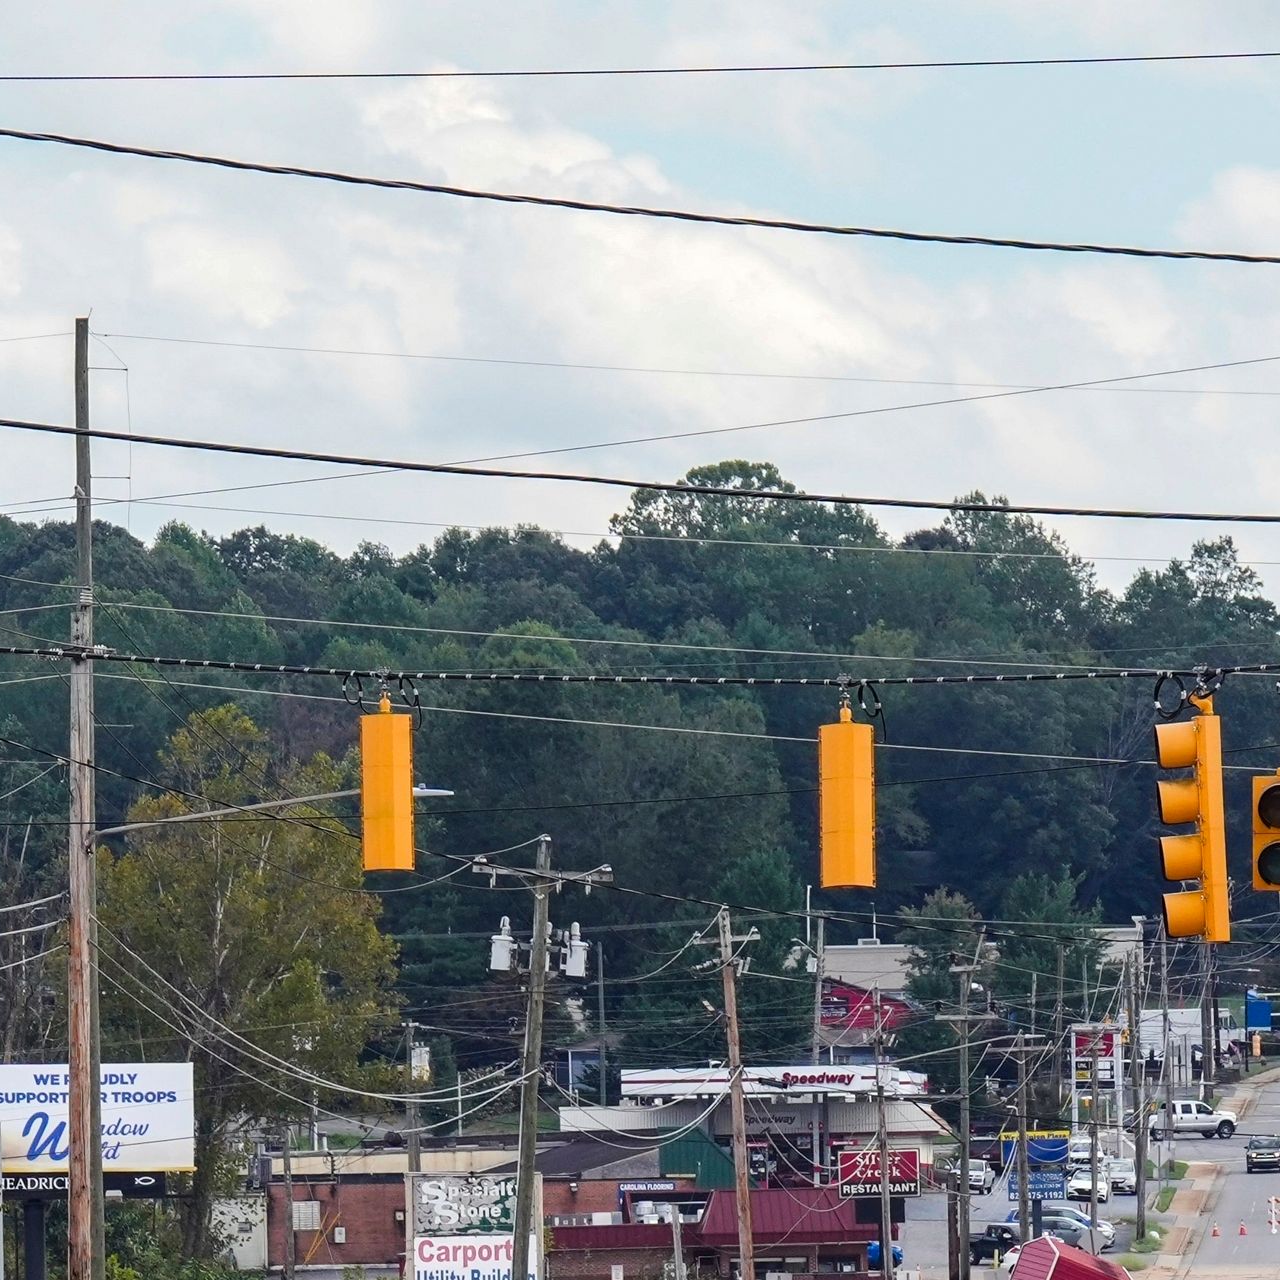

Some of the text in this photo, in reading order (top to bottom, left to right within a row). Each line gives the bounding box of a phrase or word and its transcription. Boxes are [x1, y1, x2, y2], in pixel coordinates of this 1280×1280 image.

[33, 1073, 138, 1086] WE PUDLY
[782, 1072, 855, 1086] Speedway
[114, 1091, 177, 1103] TROOPS
[856, 1166, 901, 1177] Crek
[620, 1183, 674, 1191] CAROLINA FLOORING
[434, 1201, 502, 1225] Stone
